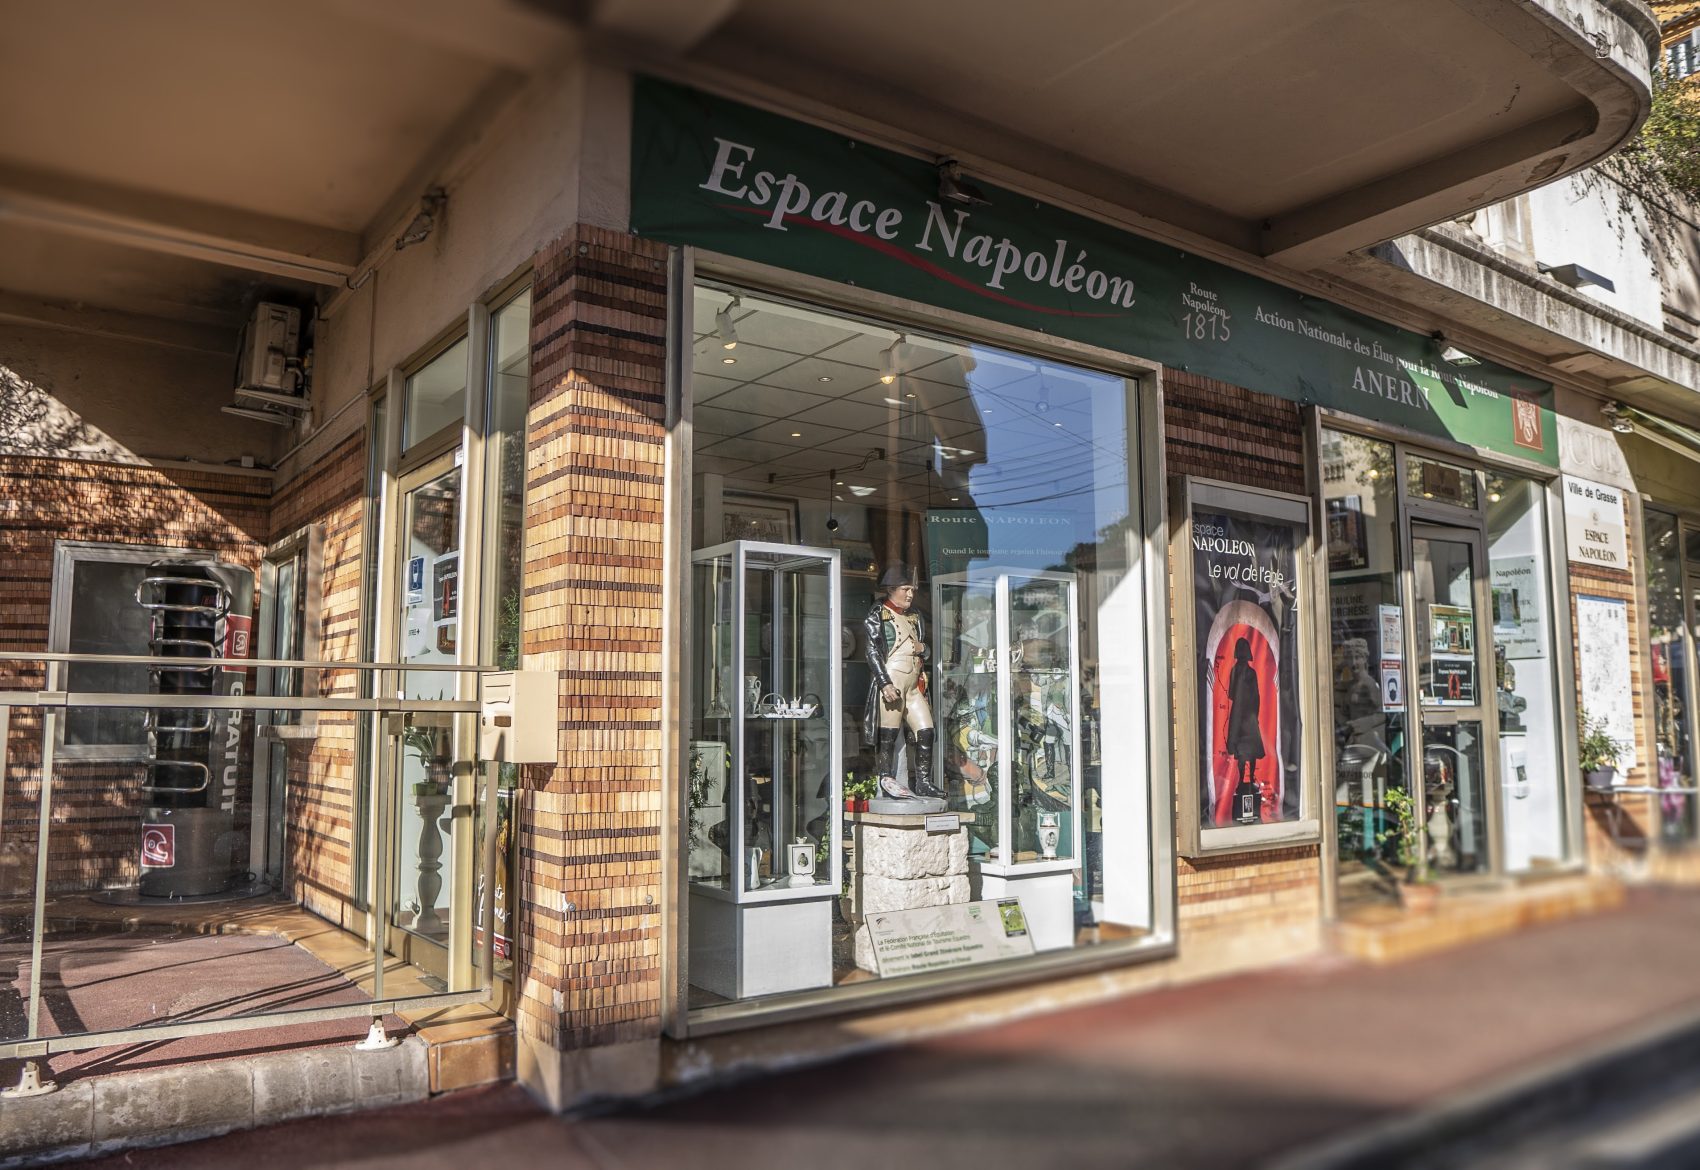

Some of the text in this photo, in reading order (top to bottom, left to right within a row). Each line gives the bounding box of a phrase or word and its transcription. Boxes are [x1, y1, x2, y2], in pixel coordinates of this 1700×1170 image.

[698, 136, 1137, 309] Espace Napoléon
[1190, 281, 1218, 301] Route
[1182, 292, 1226, 316] Napoléon
[1182, 313, 1231, 342] 1815
[1254, 305, 1295, 332] Action
[1297, 318, 1352, 350] Nationale
[1354, 337, 1370, 356] des
[1373, 340, 1394, 364] Élus
[1396, 355, 1418, 373] pour
[1420, 359, 1430, 378] la
[1431, 363, 1456, 385] Route
[1352, 366, 1429, 411] ANERN
[1568, 481, 1617, 504] Ville de Grasse
[931, 515, 1071, 526] Route NAPOLEON
[1585, 529, 1609, 544] ESPACE
[942, 547, 967, 556] Quand
[968, 547, 976, 555] le
[1192, 537, 1256, 558] NAPOLEON
[1208, 560, 1221, 578] Le
[1224, 563, 1240, 580] vol
[1242, 564, 1258, 581] de
[1495, 567, 1532, 578] Napoléon
